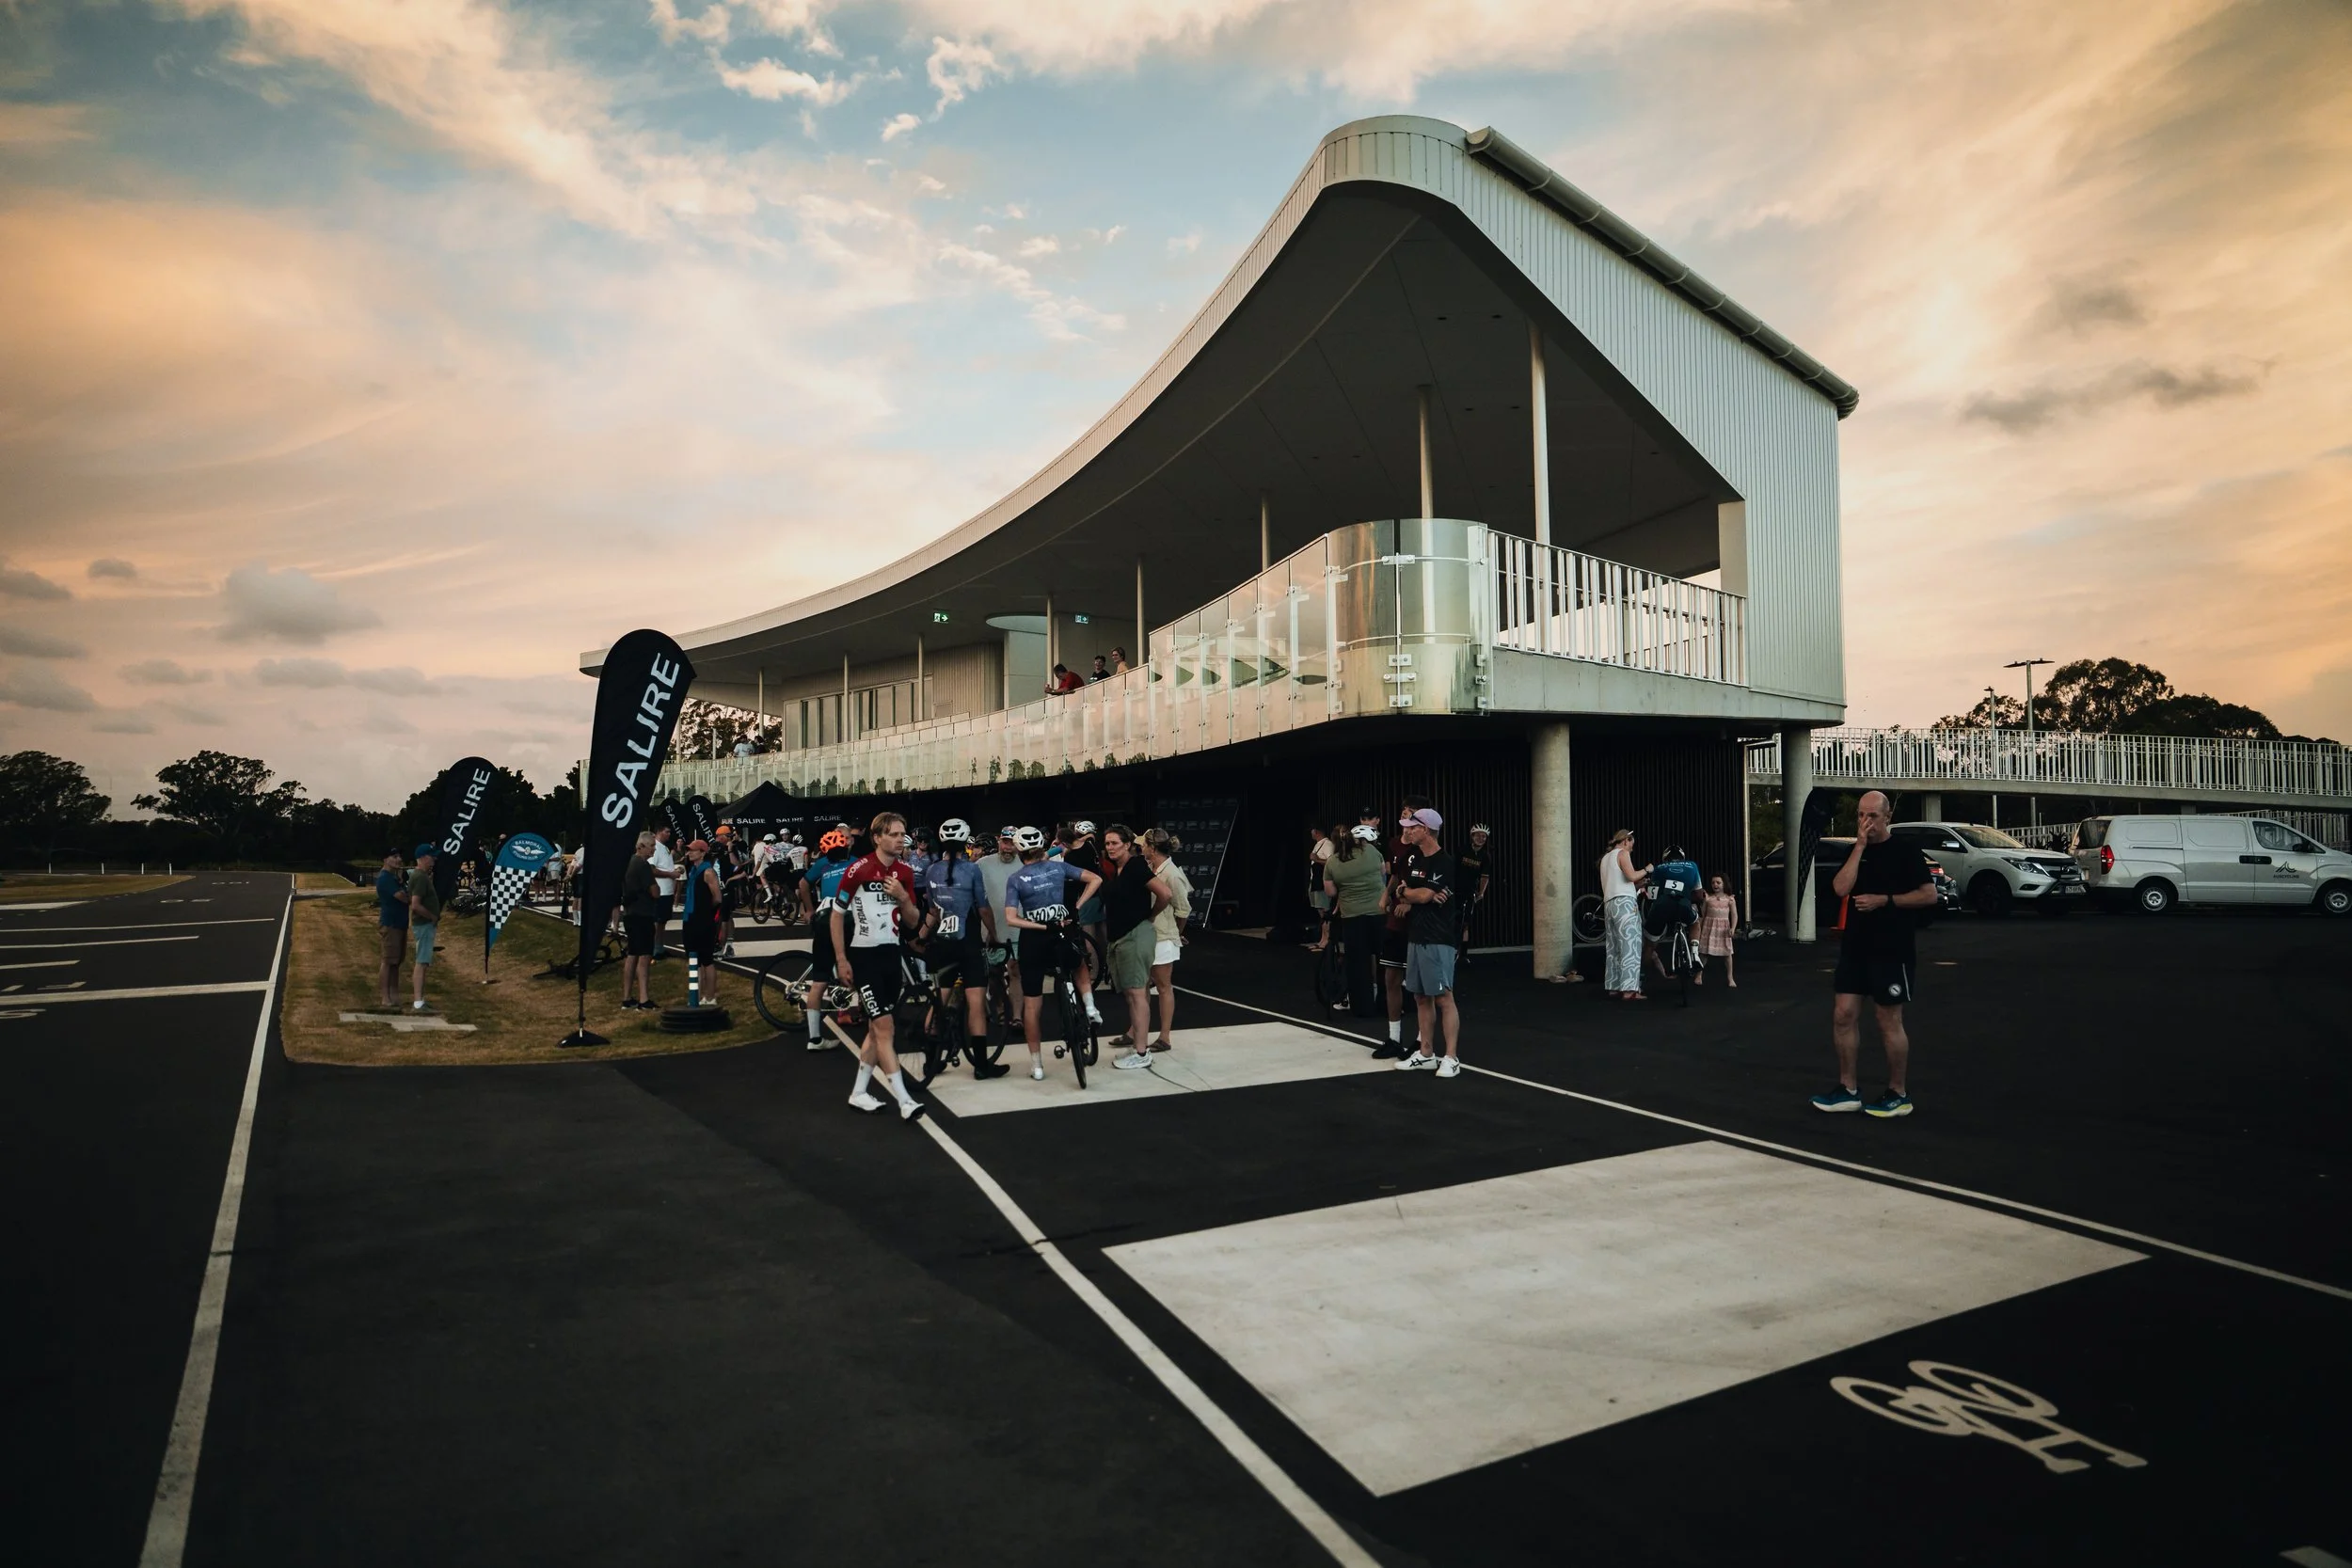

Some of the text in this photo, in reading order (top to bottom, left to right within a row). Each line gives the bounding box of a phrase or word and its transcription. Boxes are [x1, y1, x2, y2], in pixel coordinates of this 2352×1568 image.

[602, 653, 680, 829] SALIRE
[443, 768, 491, 855] SALIRE
[848, 857, 868, 879] COBRAS
[854, 895, 868, 925] PEDALER
[941, 917, 957, 932] 241
[860, 984, 882, 1017] LEIGH
